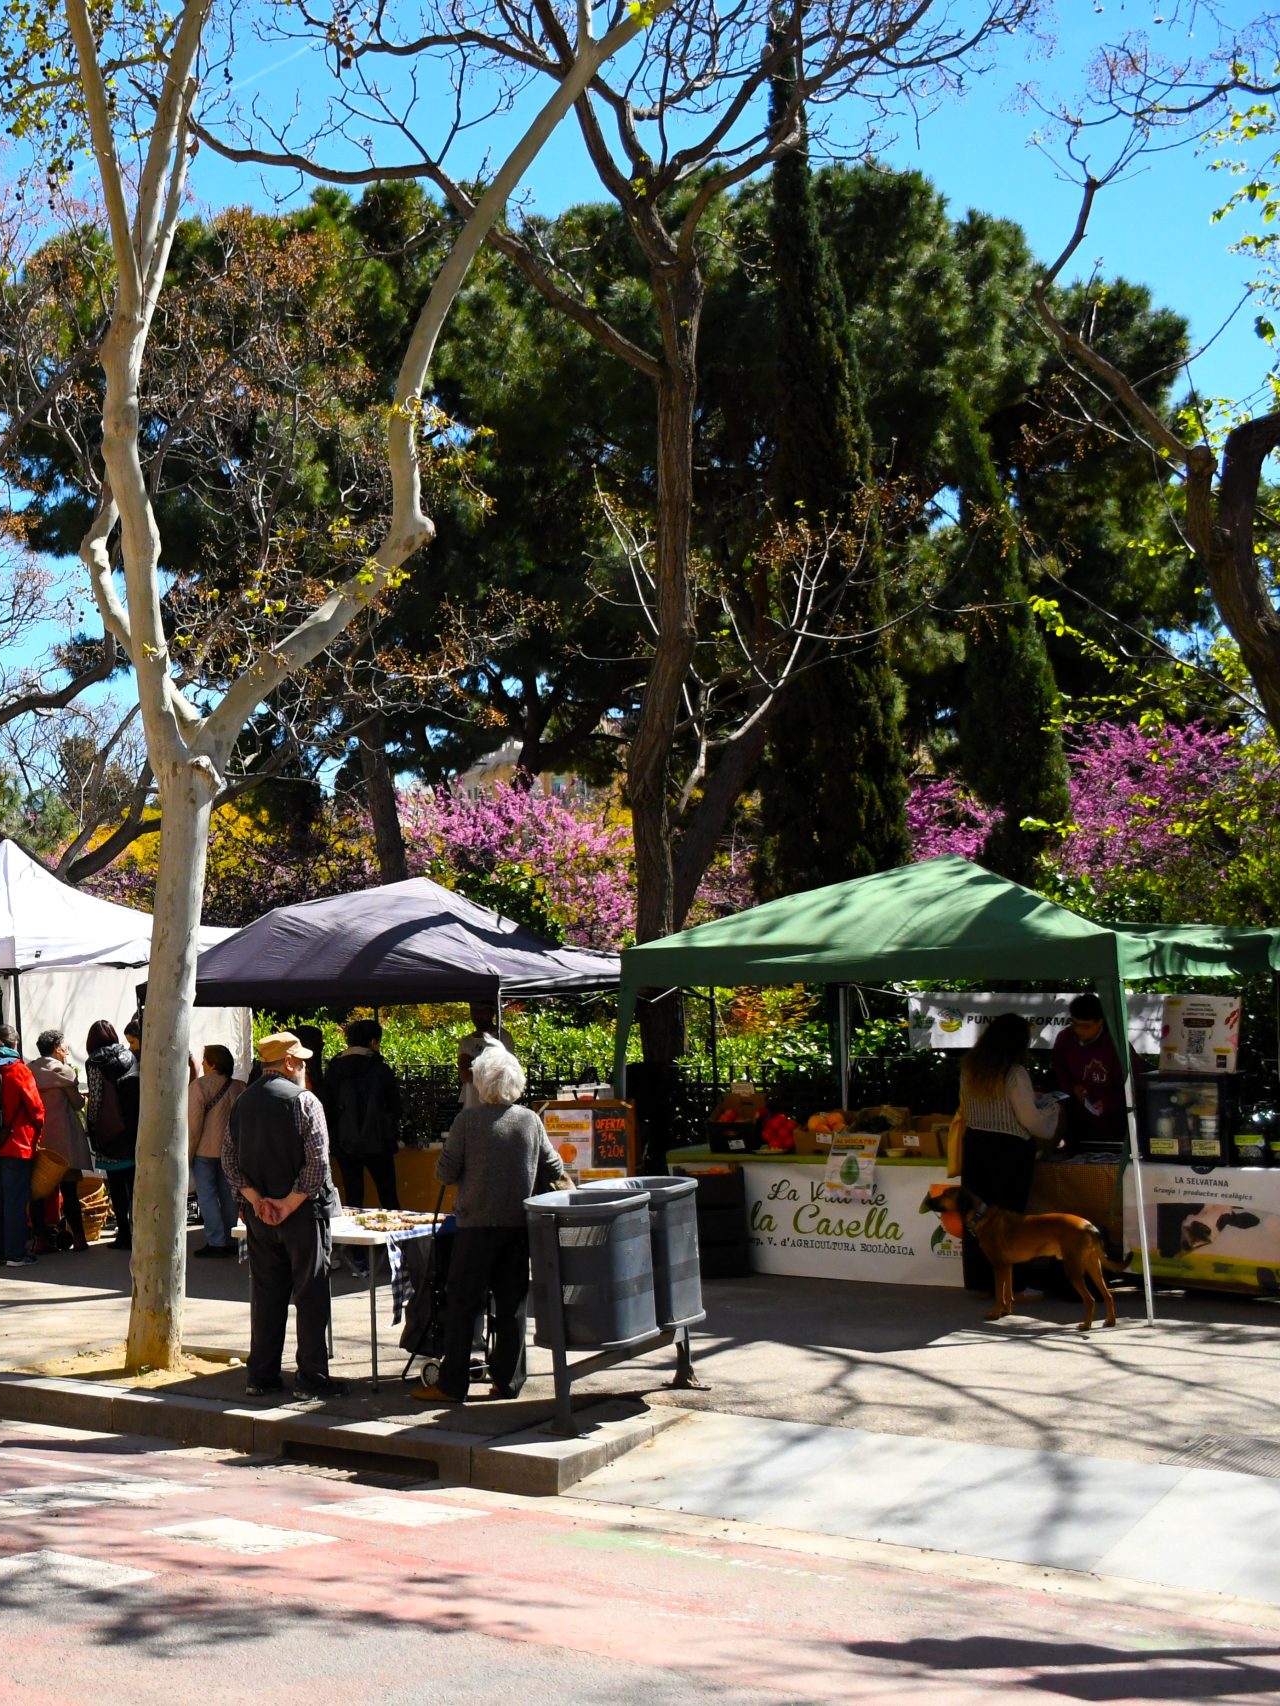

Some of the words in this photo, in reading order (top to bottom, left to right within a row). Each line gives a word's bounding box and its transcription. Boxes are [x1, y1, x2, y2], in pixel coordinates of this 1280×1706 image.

[595, 1118, 625, 1130] OFERTA
[1174, 1177, 1184, 1185] LA
[1186, 1178, 1229, 1188] SELVATANA
[767, 1179, 800, 1202] La
[750, 1201, 778, 1233] la
[793, 1203, 904, 1241] Casella
[780, 1237, 856, 1252] d'AGRICULTURA
